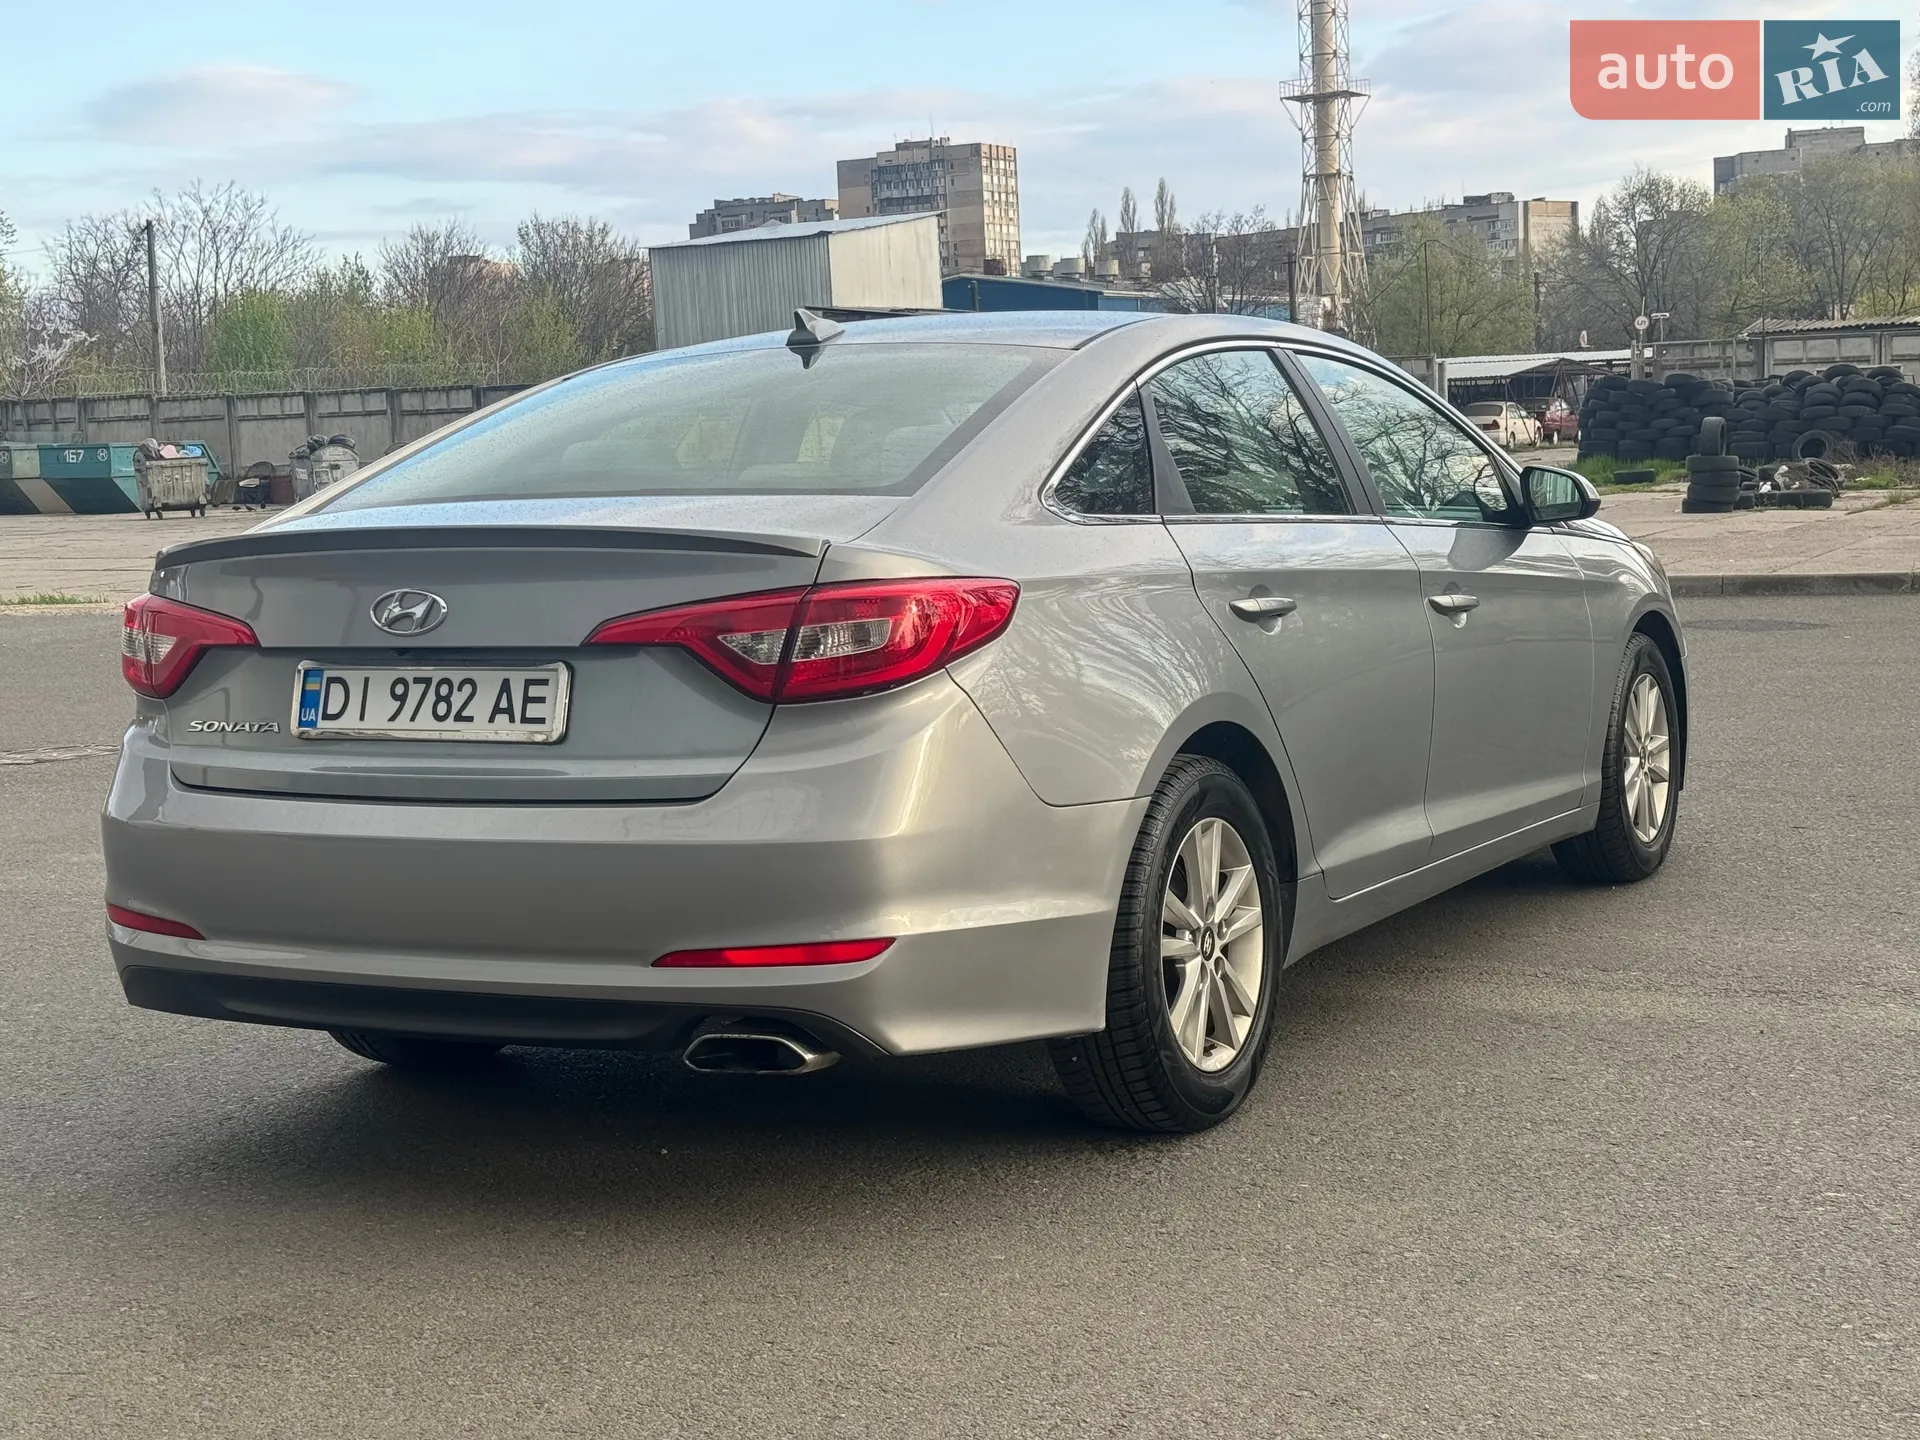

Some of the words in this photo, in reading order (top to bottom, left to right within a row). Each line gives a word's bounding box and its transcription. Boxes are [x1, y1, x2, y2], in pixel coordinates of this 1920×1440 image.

[63, 450, 84, 463] 167
[322, 677, 369, 722] DI
[387, 677, 478, 722] 9782
[488, 678, 551, 725] AE
[301, 707, 316, 722] UA
[186, 720, 281, 734] SONATA
